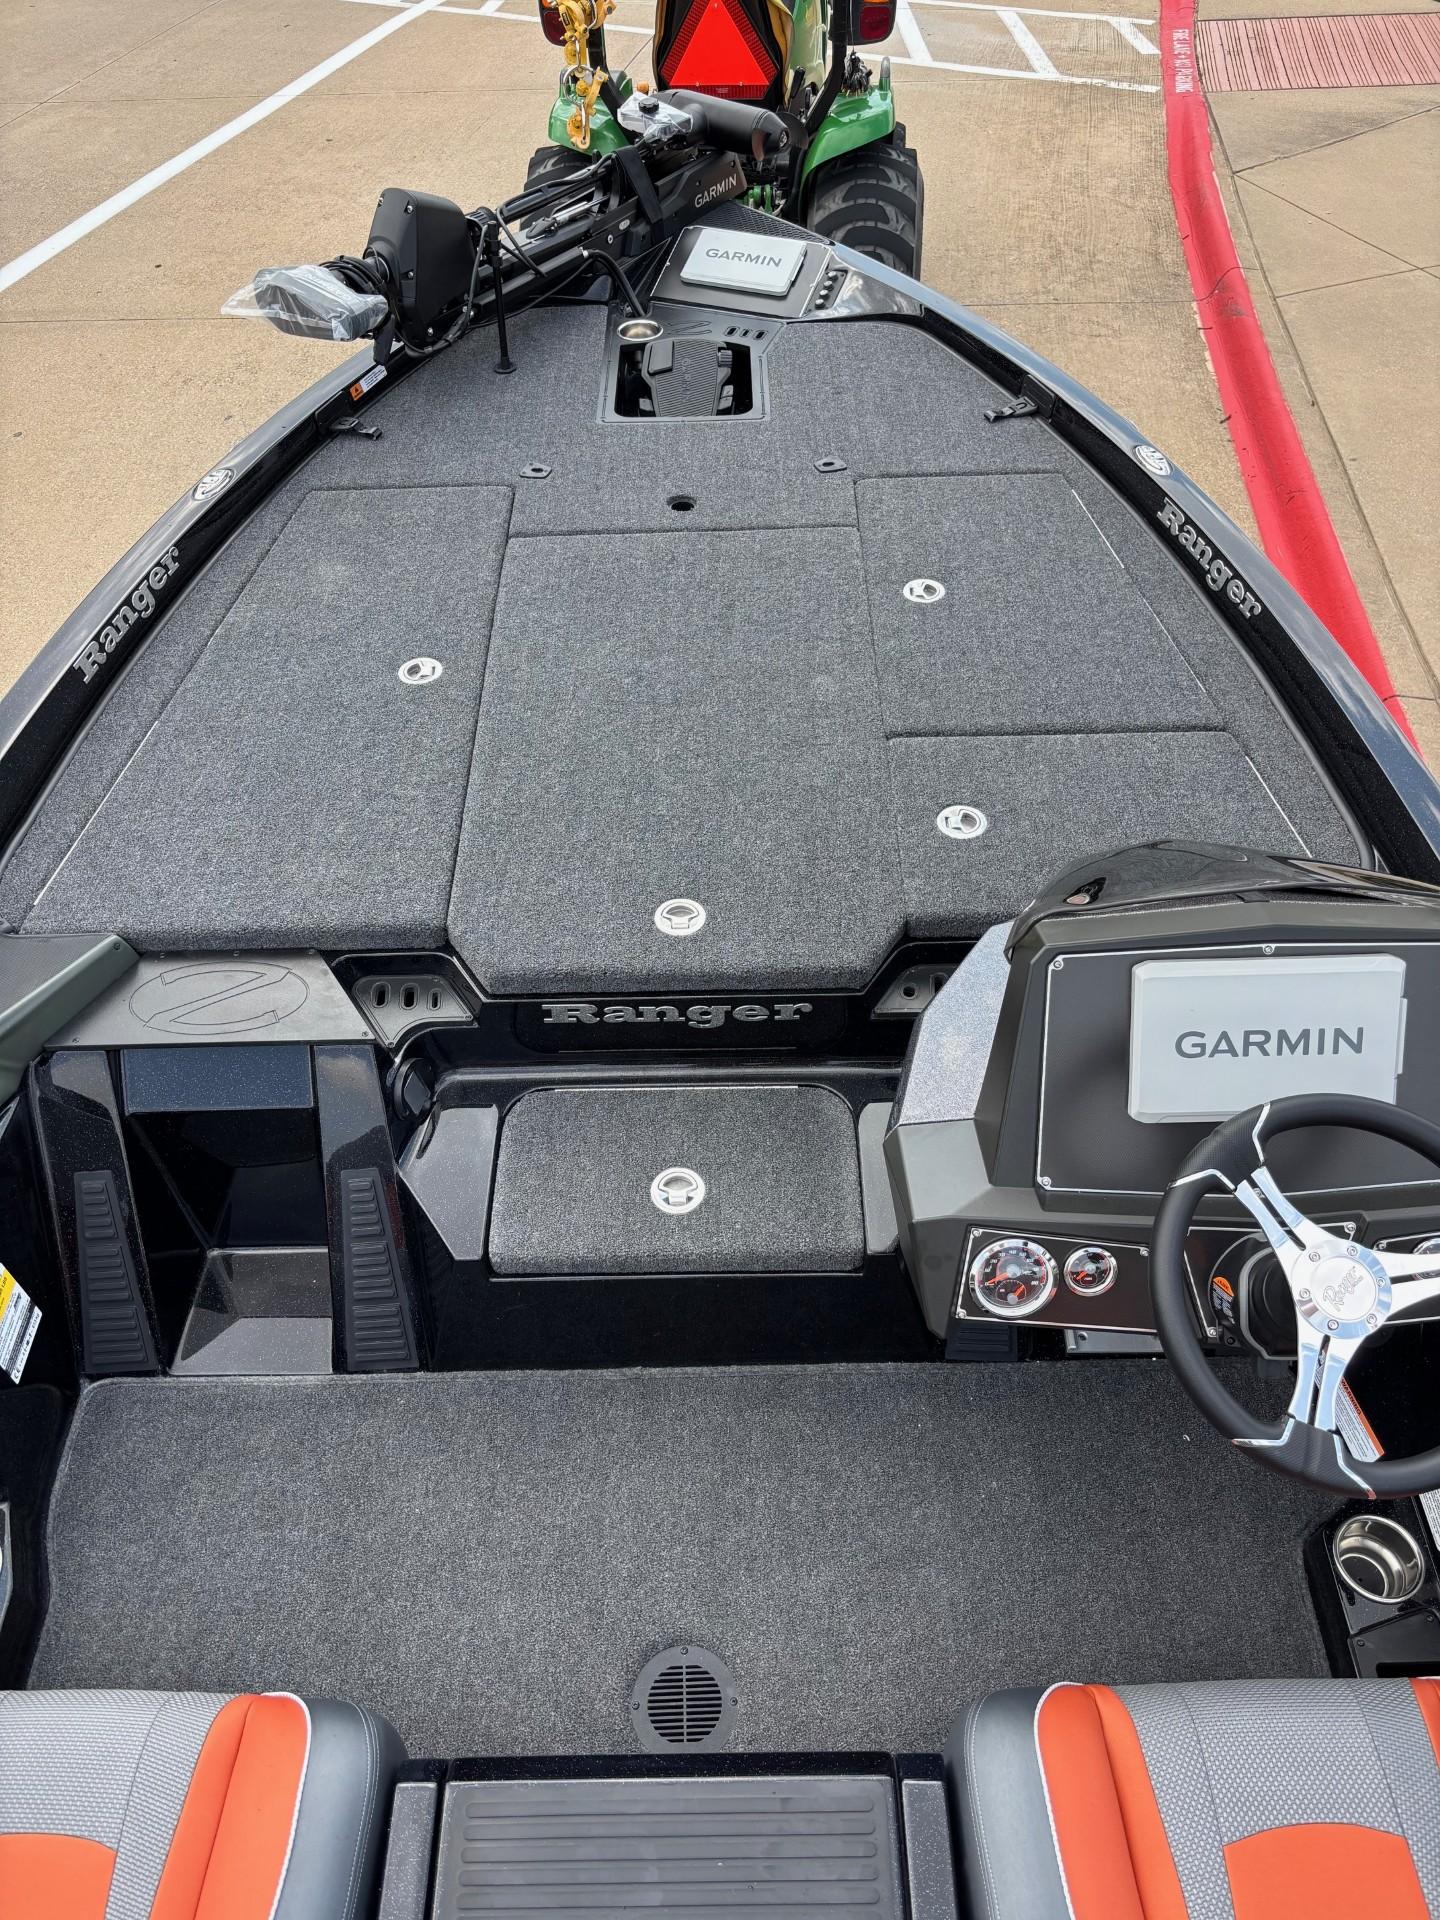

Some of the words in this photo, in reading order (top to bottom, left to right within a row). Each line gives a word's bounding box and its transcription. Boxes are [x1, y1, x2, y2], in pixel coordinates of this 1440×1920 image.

[1175, 68, 1194, 93] PARKING
[694, 174, 738, 208] GARMIN
[705, 248, 782, 267] GARMIN
[1156, 497, 1263, 619] Ranger
[73, 546, 179, 683] Ranger
[541, 1002, 814, 1029] Ranger
[1174, 1026, 1364, 1059] GARMIN
